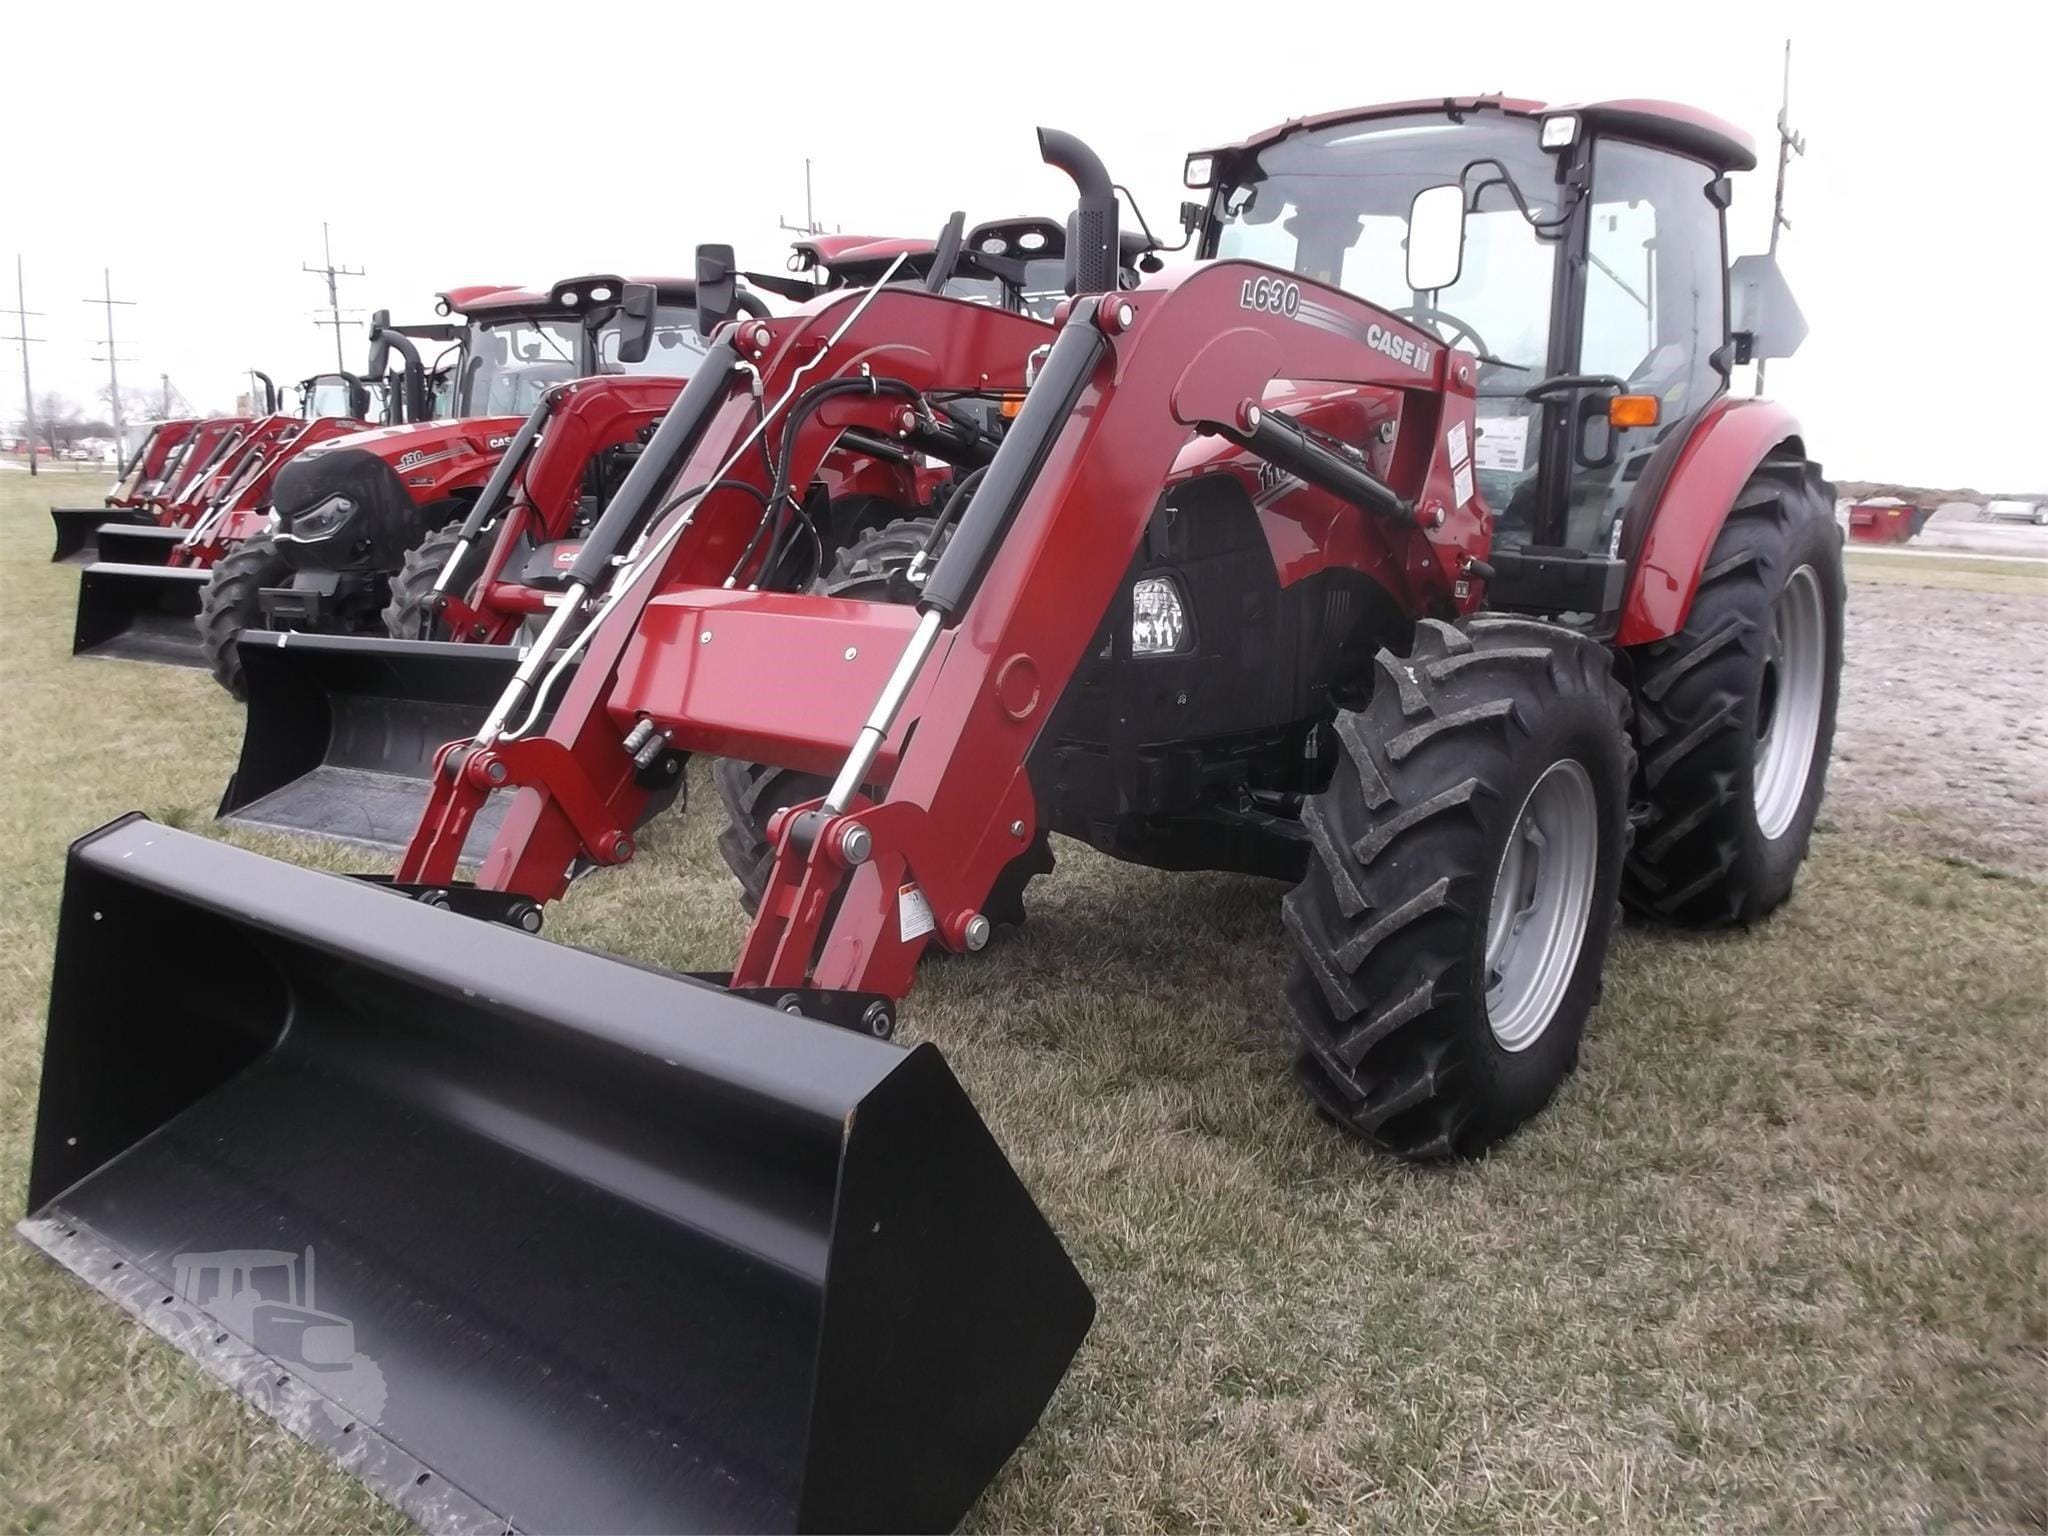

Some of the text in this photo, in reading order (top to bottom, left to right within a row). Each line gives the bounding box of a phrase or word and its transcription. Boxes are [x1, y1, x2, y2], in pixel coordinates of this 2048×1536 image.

[1240, 276, 1300, 317] L630
[1367, 323, 1415, 365] CASE
[490, 436, 512, 448] CAS
[400, 450, 423, 466] 130
